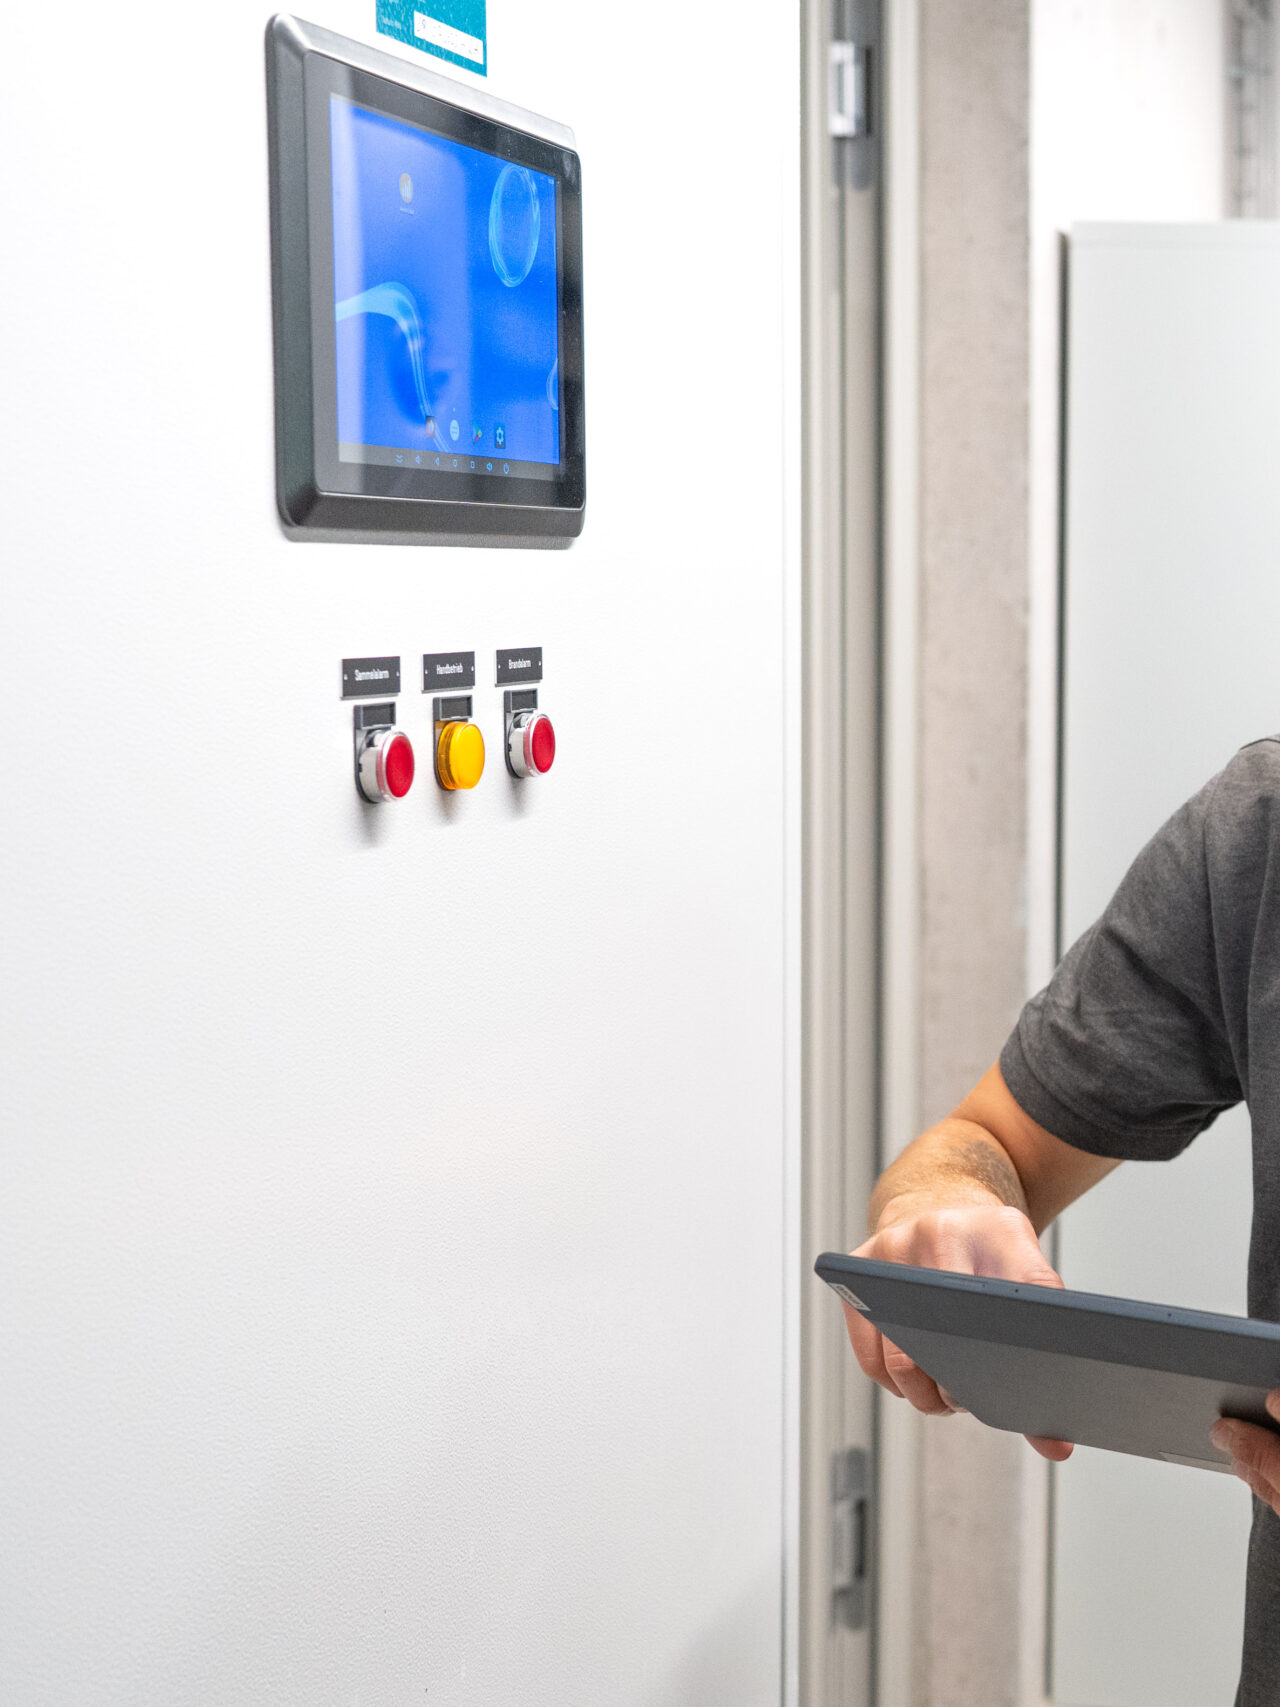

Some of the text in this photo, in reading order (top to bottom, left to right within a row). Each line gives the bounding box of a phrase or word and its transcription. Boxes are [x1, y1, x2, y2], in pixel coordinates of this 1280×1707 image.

[436, 662, 463, 675] Handbetrieb
[508, 658, 531, 670] Brandalarm
[354, 668, 390, 681] Sammelalarm
